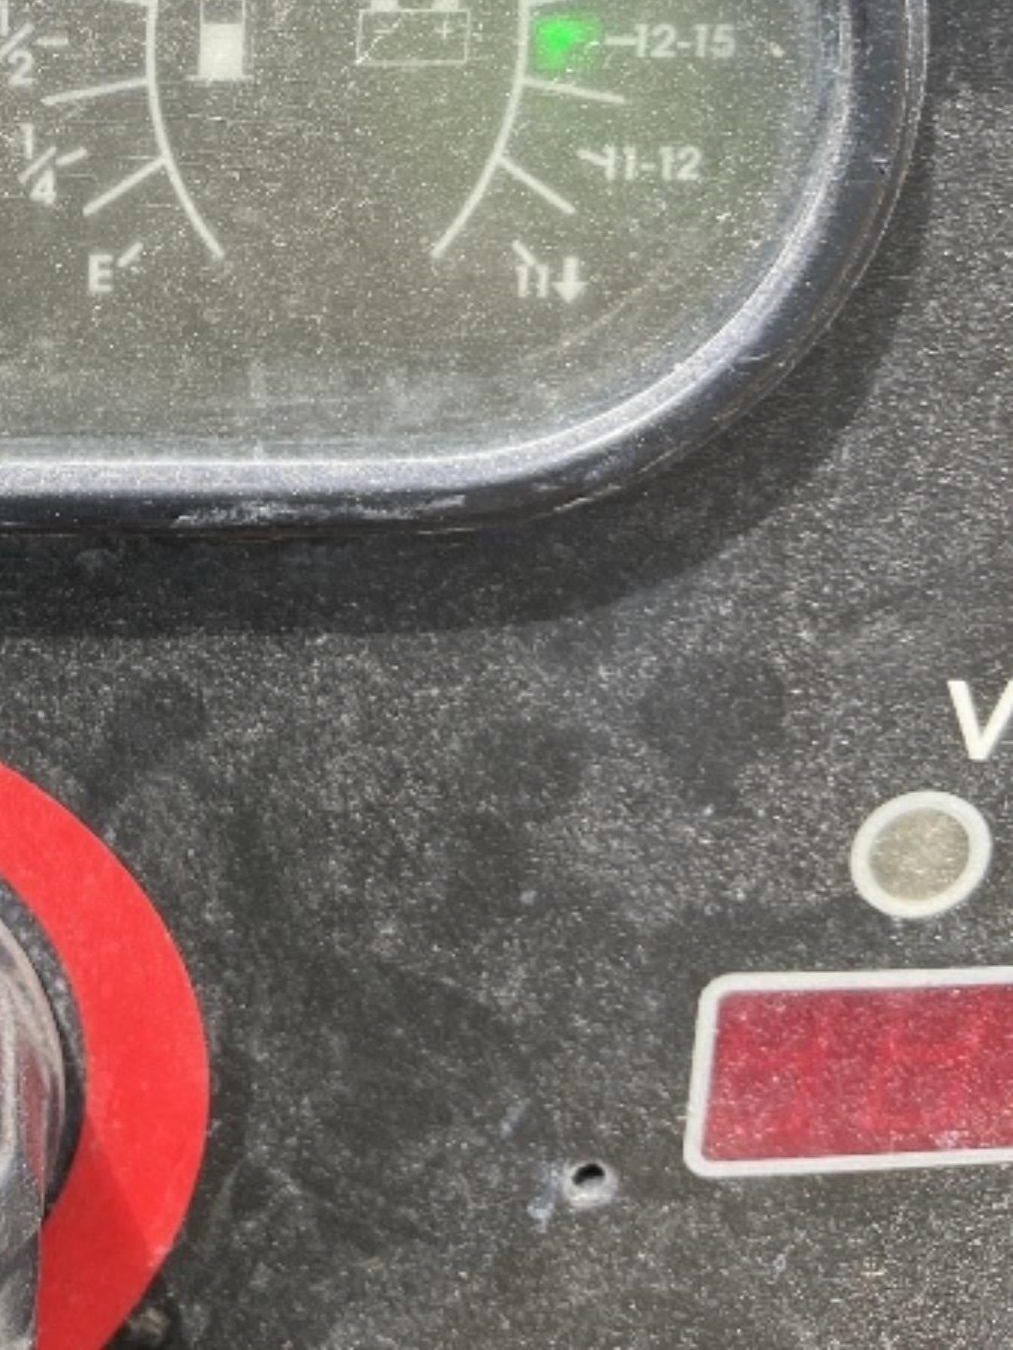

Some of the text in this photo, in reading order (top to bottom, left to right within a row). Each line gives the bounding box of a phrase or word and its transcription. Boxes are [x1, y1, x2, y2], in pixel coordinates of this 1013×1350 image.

[635, 24, 736, 58] 12-15
[604, 146, 702, 181] 11-12
[87, 256, 112, 293] E
